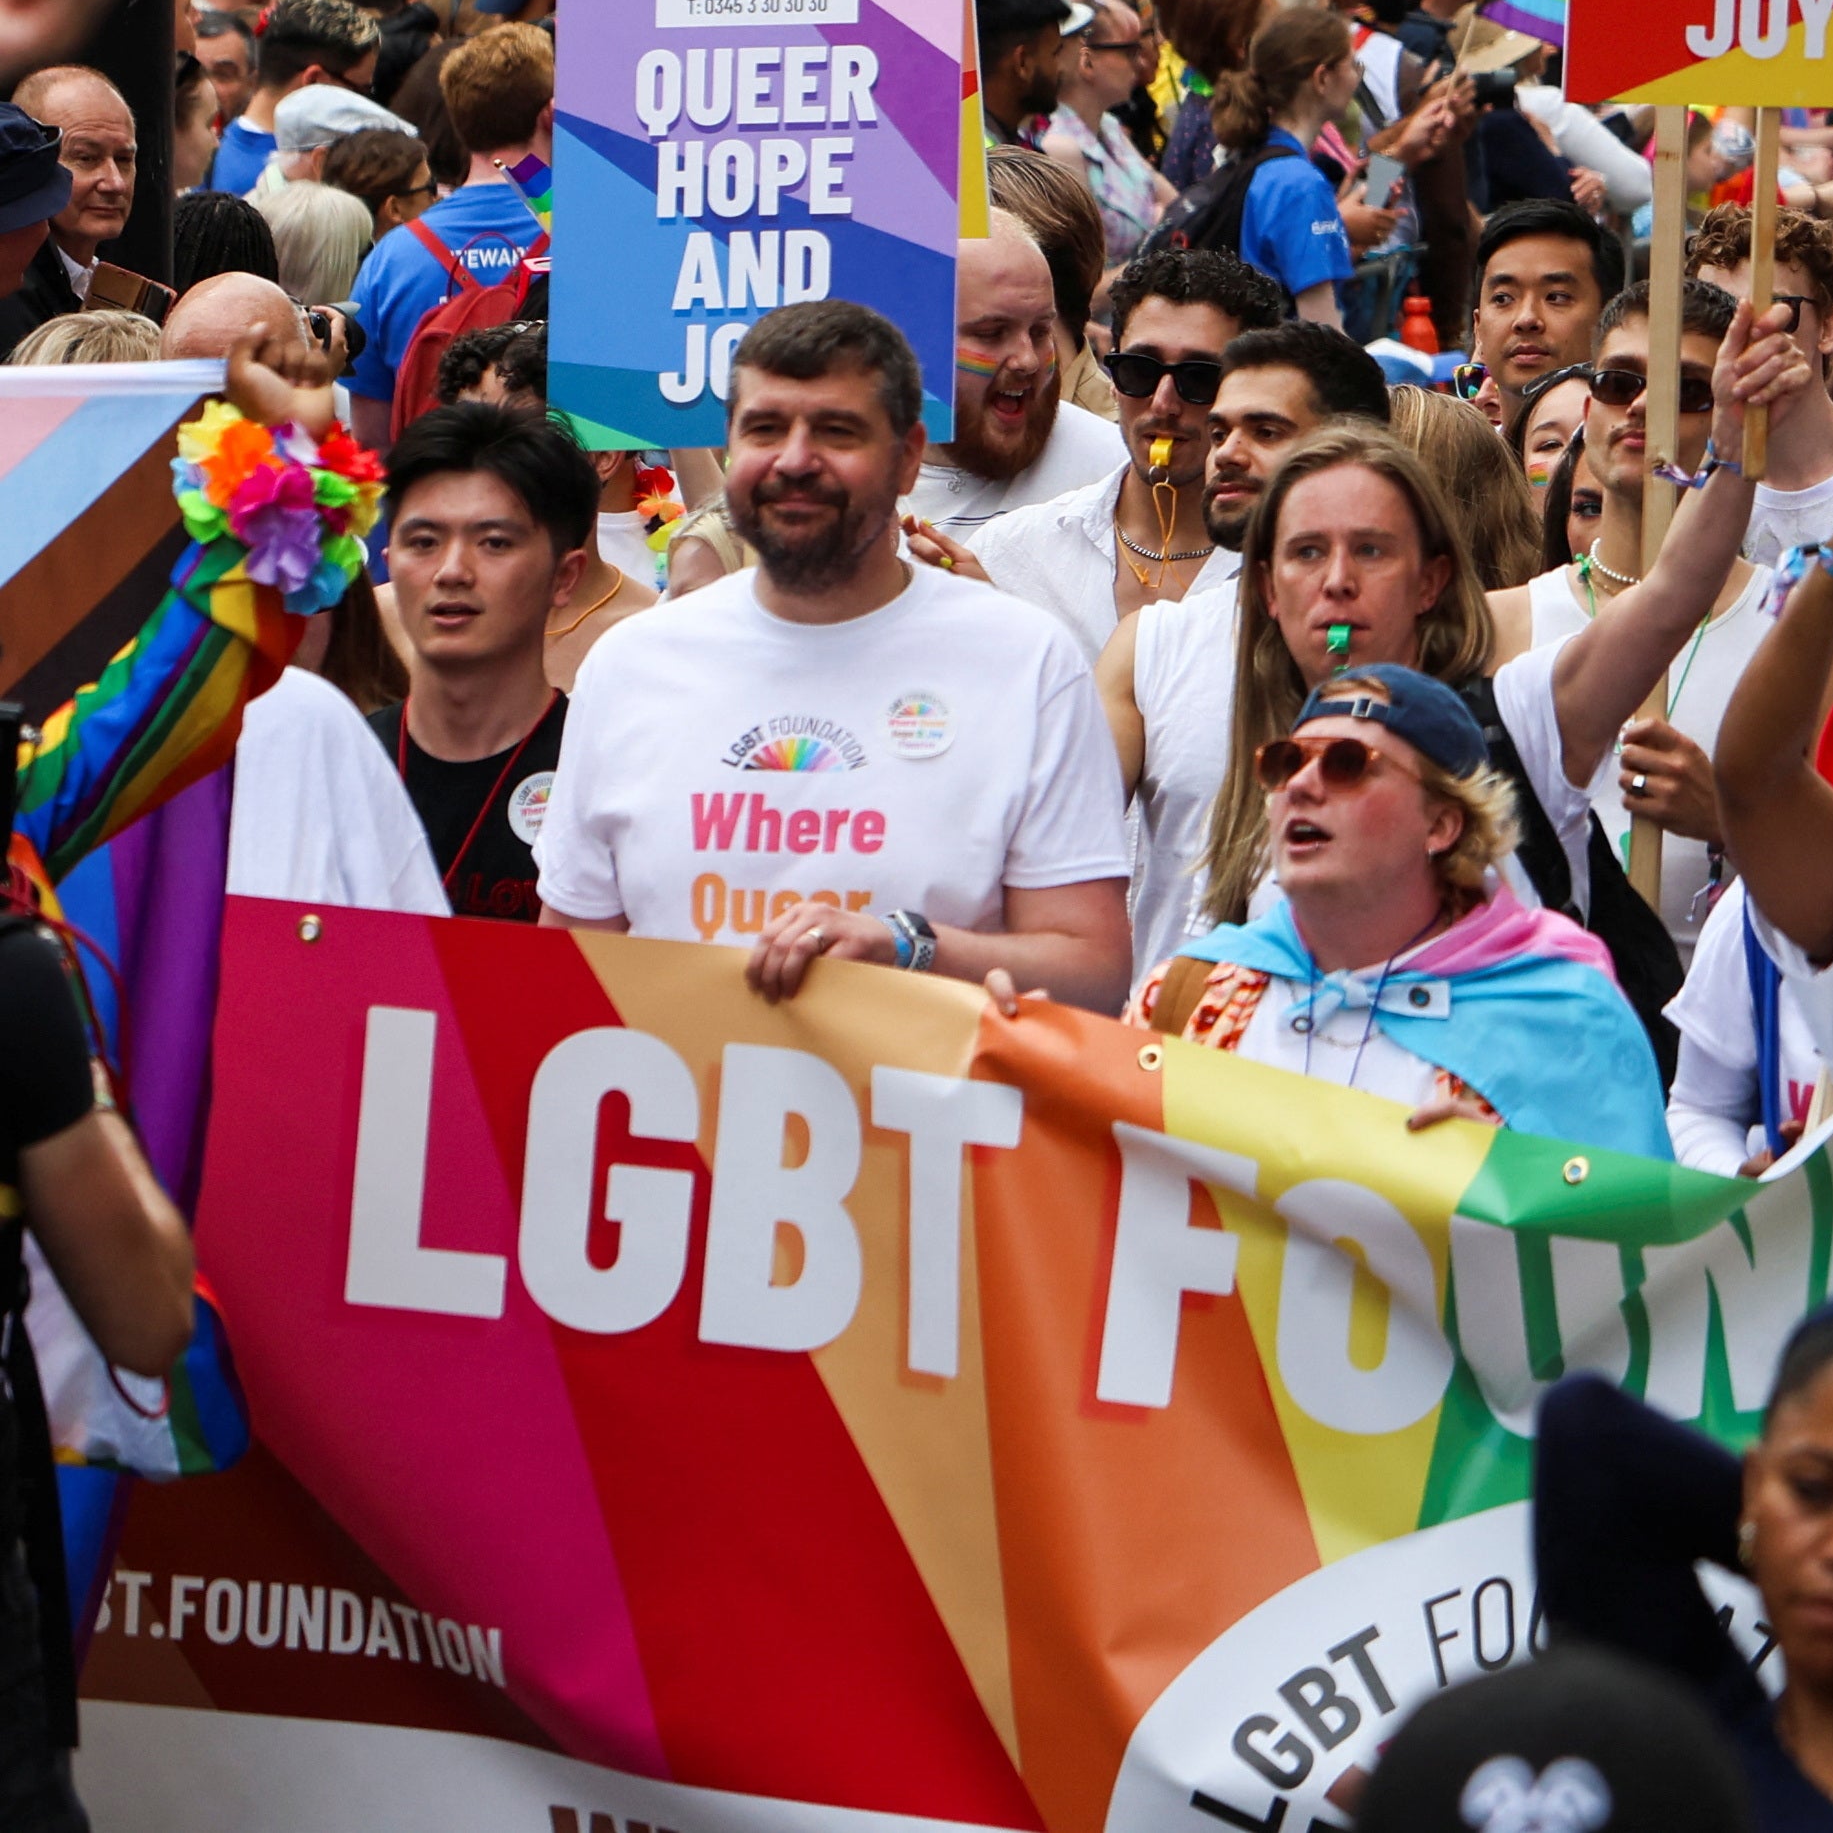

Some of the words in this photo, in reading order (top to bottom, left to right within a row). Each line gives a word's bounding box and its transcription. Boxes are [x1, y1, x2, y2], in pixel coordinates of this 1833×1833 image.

[635, 45, 878, 137] QUEER
[657, 137, 853, 218] HOPE
[448, 246, 529, 269] TEWAR
[671, 230, 832, 311] AND
[721, 726, 764, 768] LGBT
[768, 715, 868, 770] FOUNDATION
[691, 792, 886, 855] Where
[343, 1005, 1023, 1379] LGBT
[1189, 1624, 1396, 1833] LGBT
